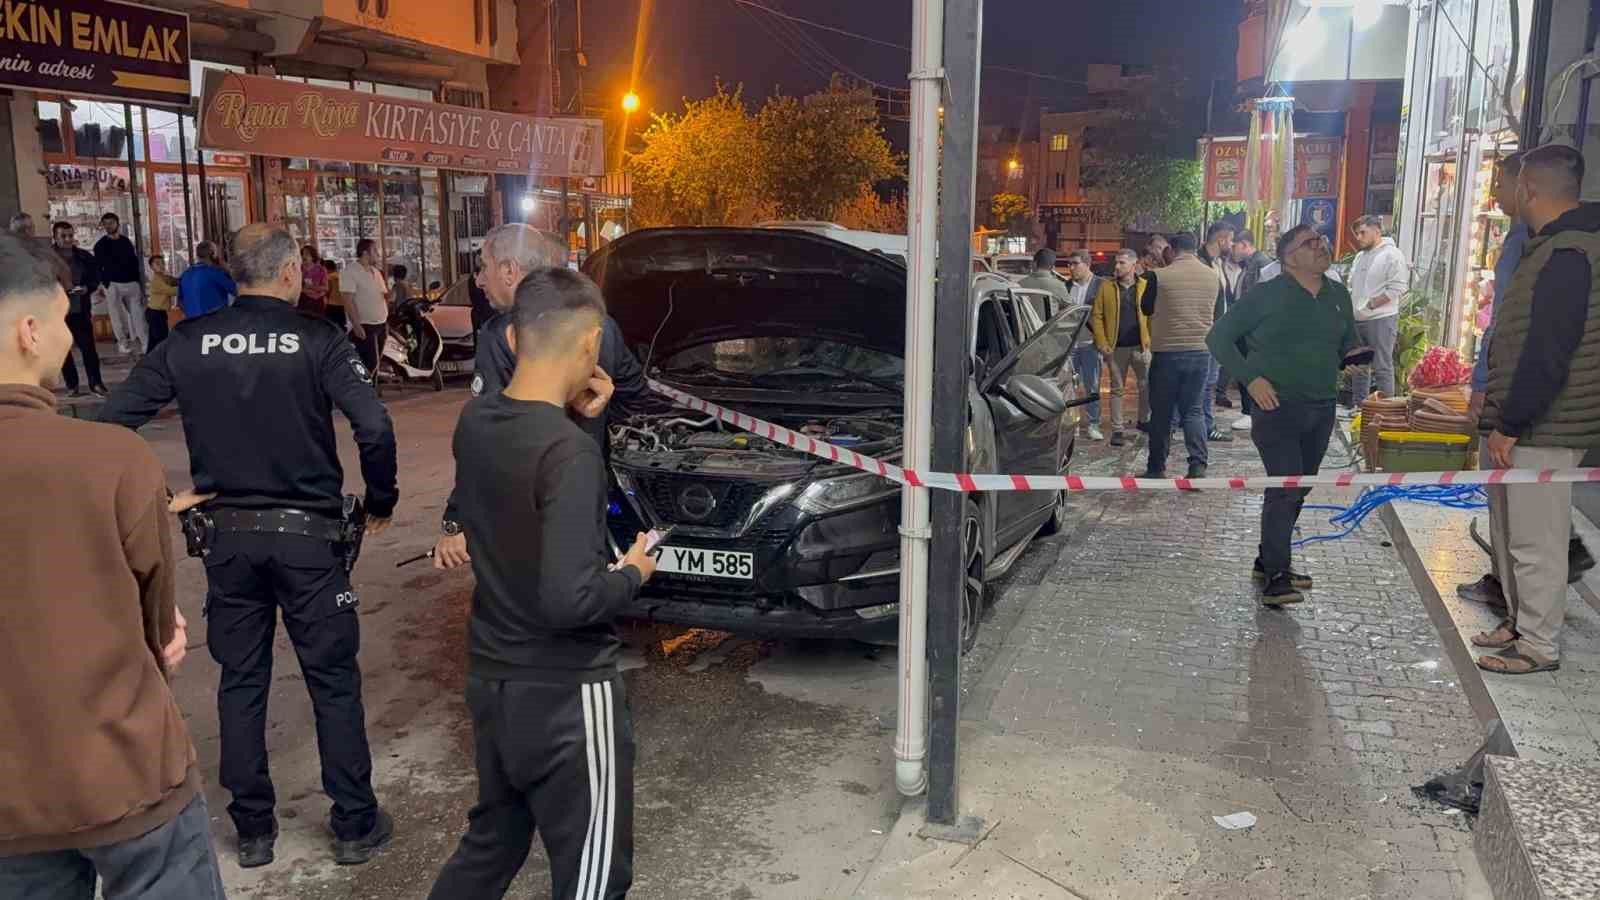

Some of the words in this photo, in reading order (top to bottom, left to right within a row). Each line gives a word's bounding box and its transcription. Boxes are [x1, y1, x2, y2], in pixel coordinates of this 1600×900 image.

[71, 12, 182, 64] EMLAK
[38, 59, 95, 80] adresi
[215, 90, 291, 143] Rana
[487, 118, 501, 150] &
[508, 120, 566, 160] ÇANTA
[674, 549, 704, 572] YM
[712, 553, 751, 576] 585
